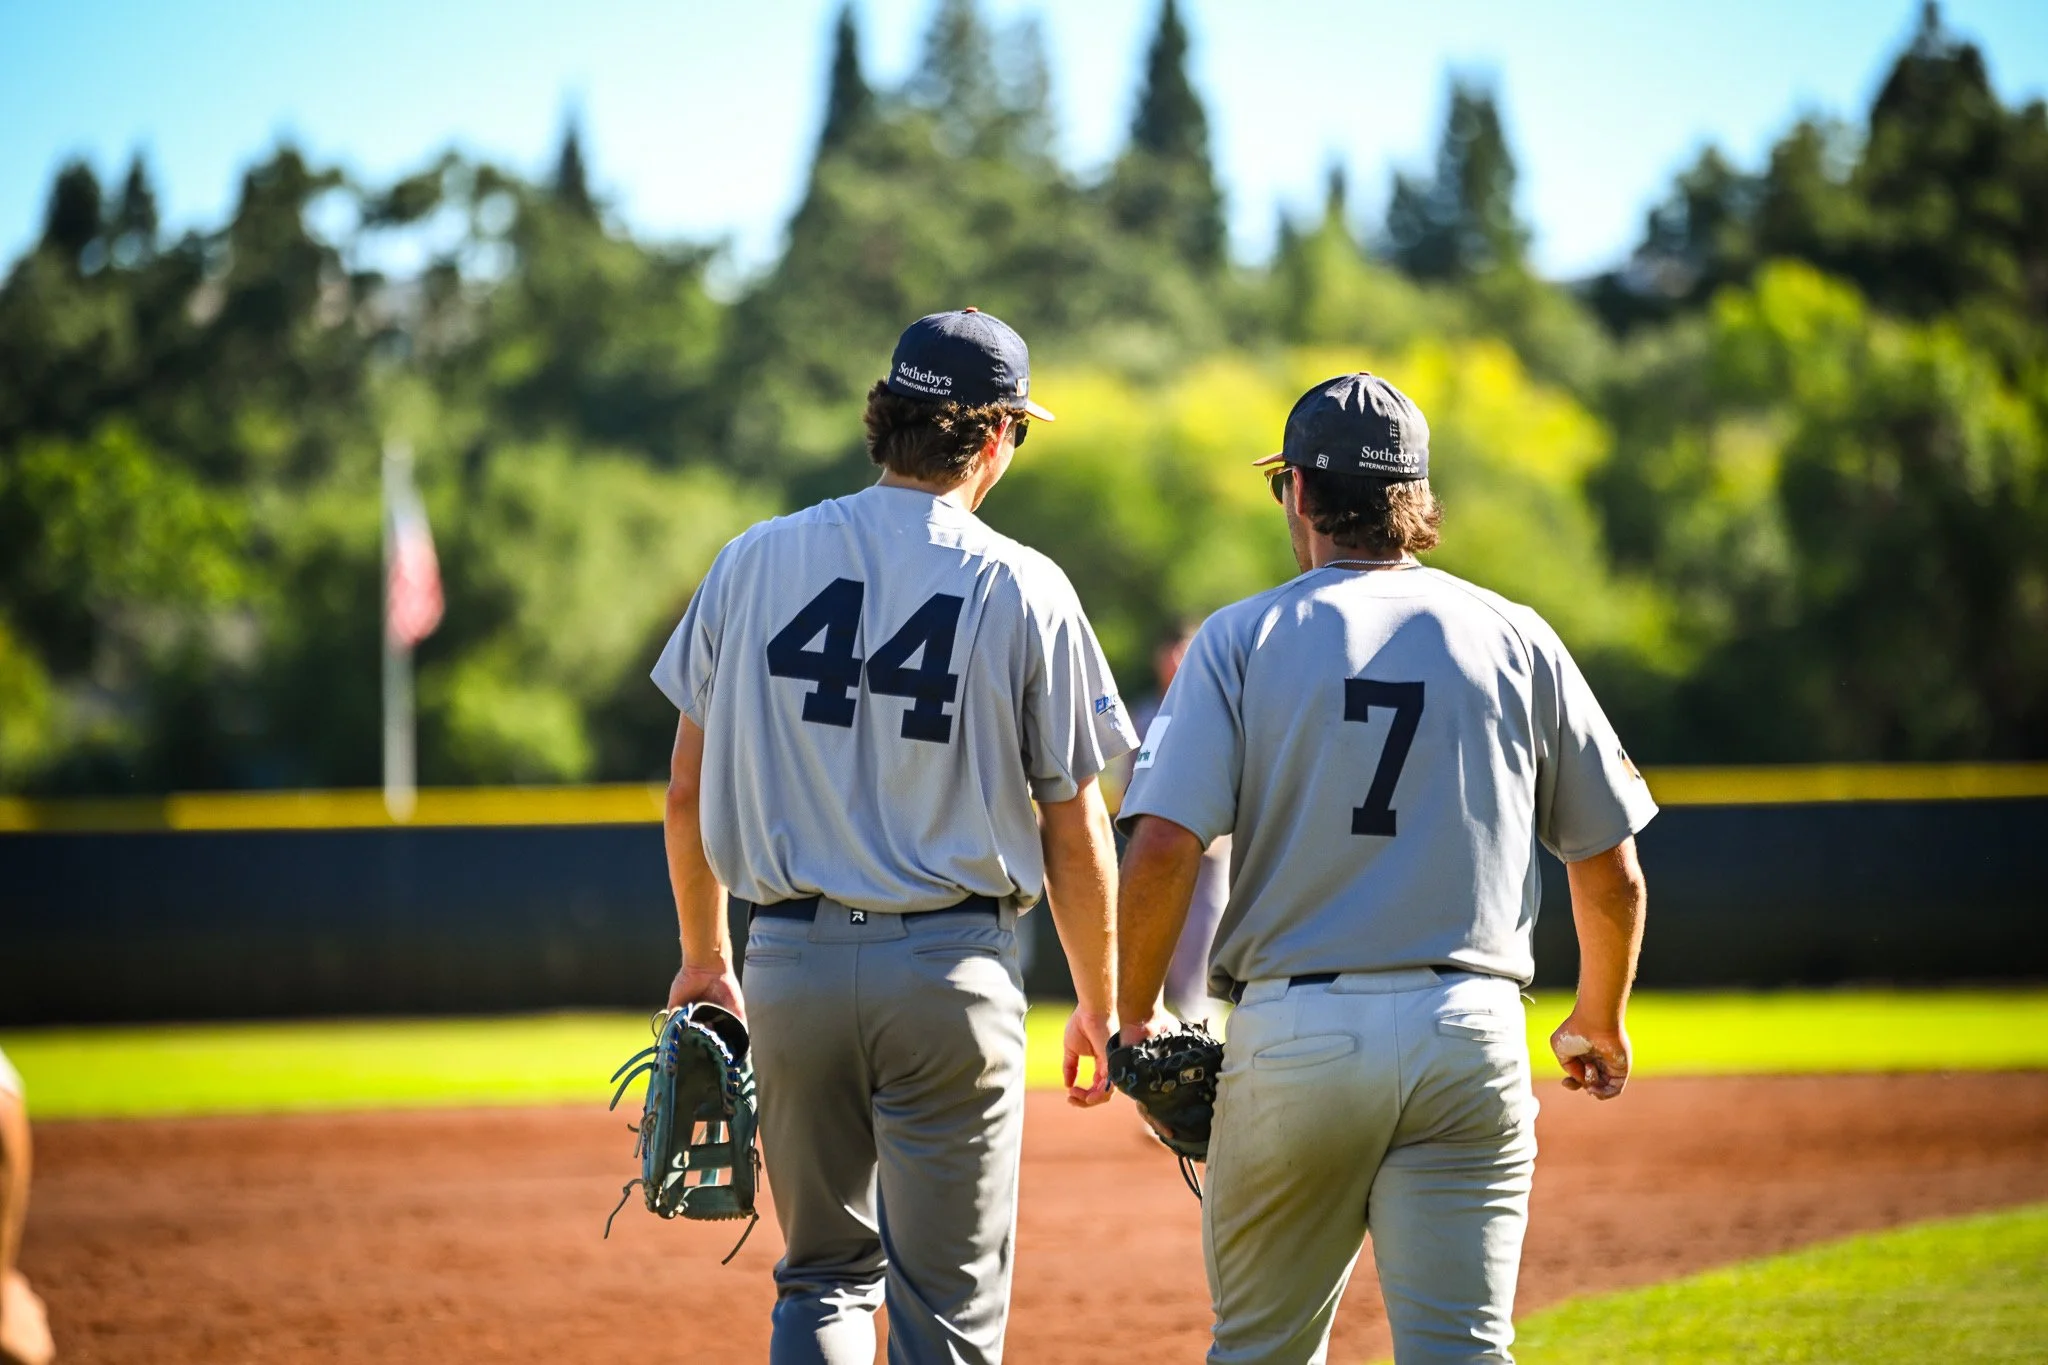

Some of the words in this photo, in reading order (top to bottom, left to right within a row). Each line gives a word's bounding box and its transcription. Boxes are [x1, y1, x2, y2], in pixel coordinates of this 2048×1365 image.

[895, 376, 929, 393] INTERNATIONAL
[929, 387, 951, 396] REALTY
[899, 362, 952, 387] Sotheby's
[1359, 461, 1404, 473] INTERNATIONAL
[1361, 445, 1420, 466] Sotheby's
[766, 577, 965, 744] 44
[1344, 678, 1425, 837] 7
